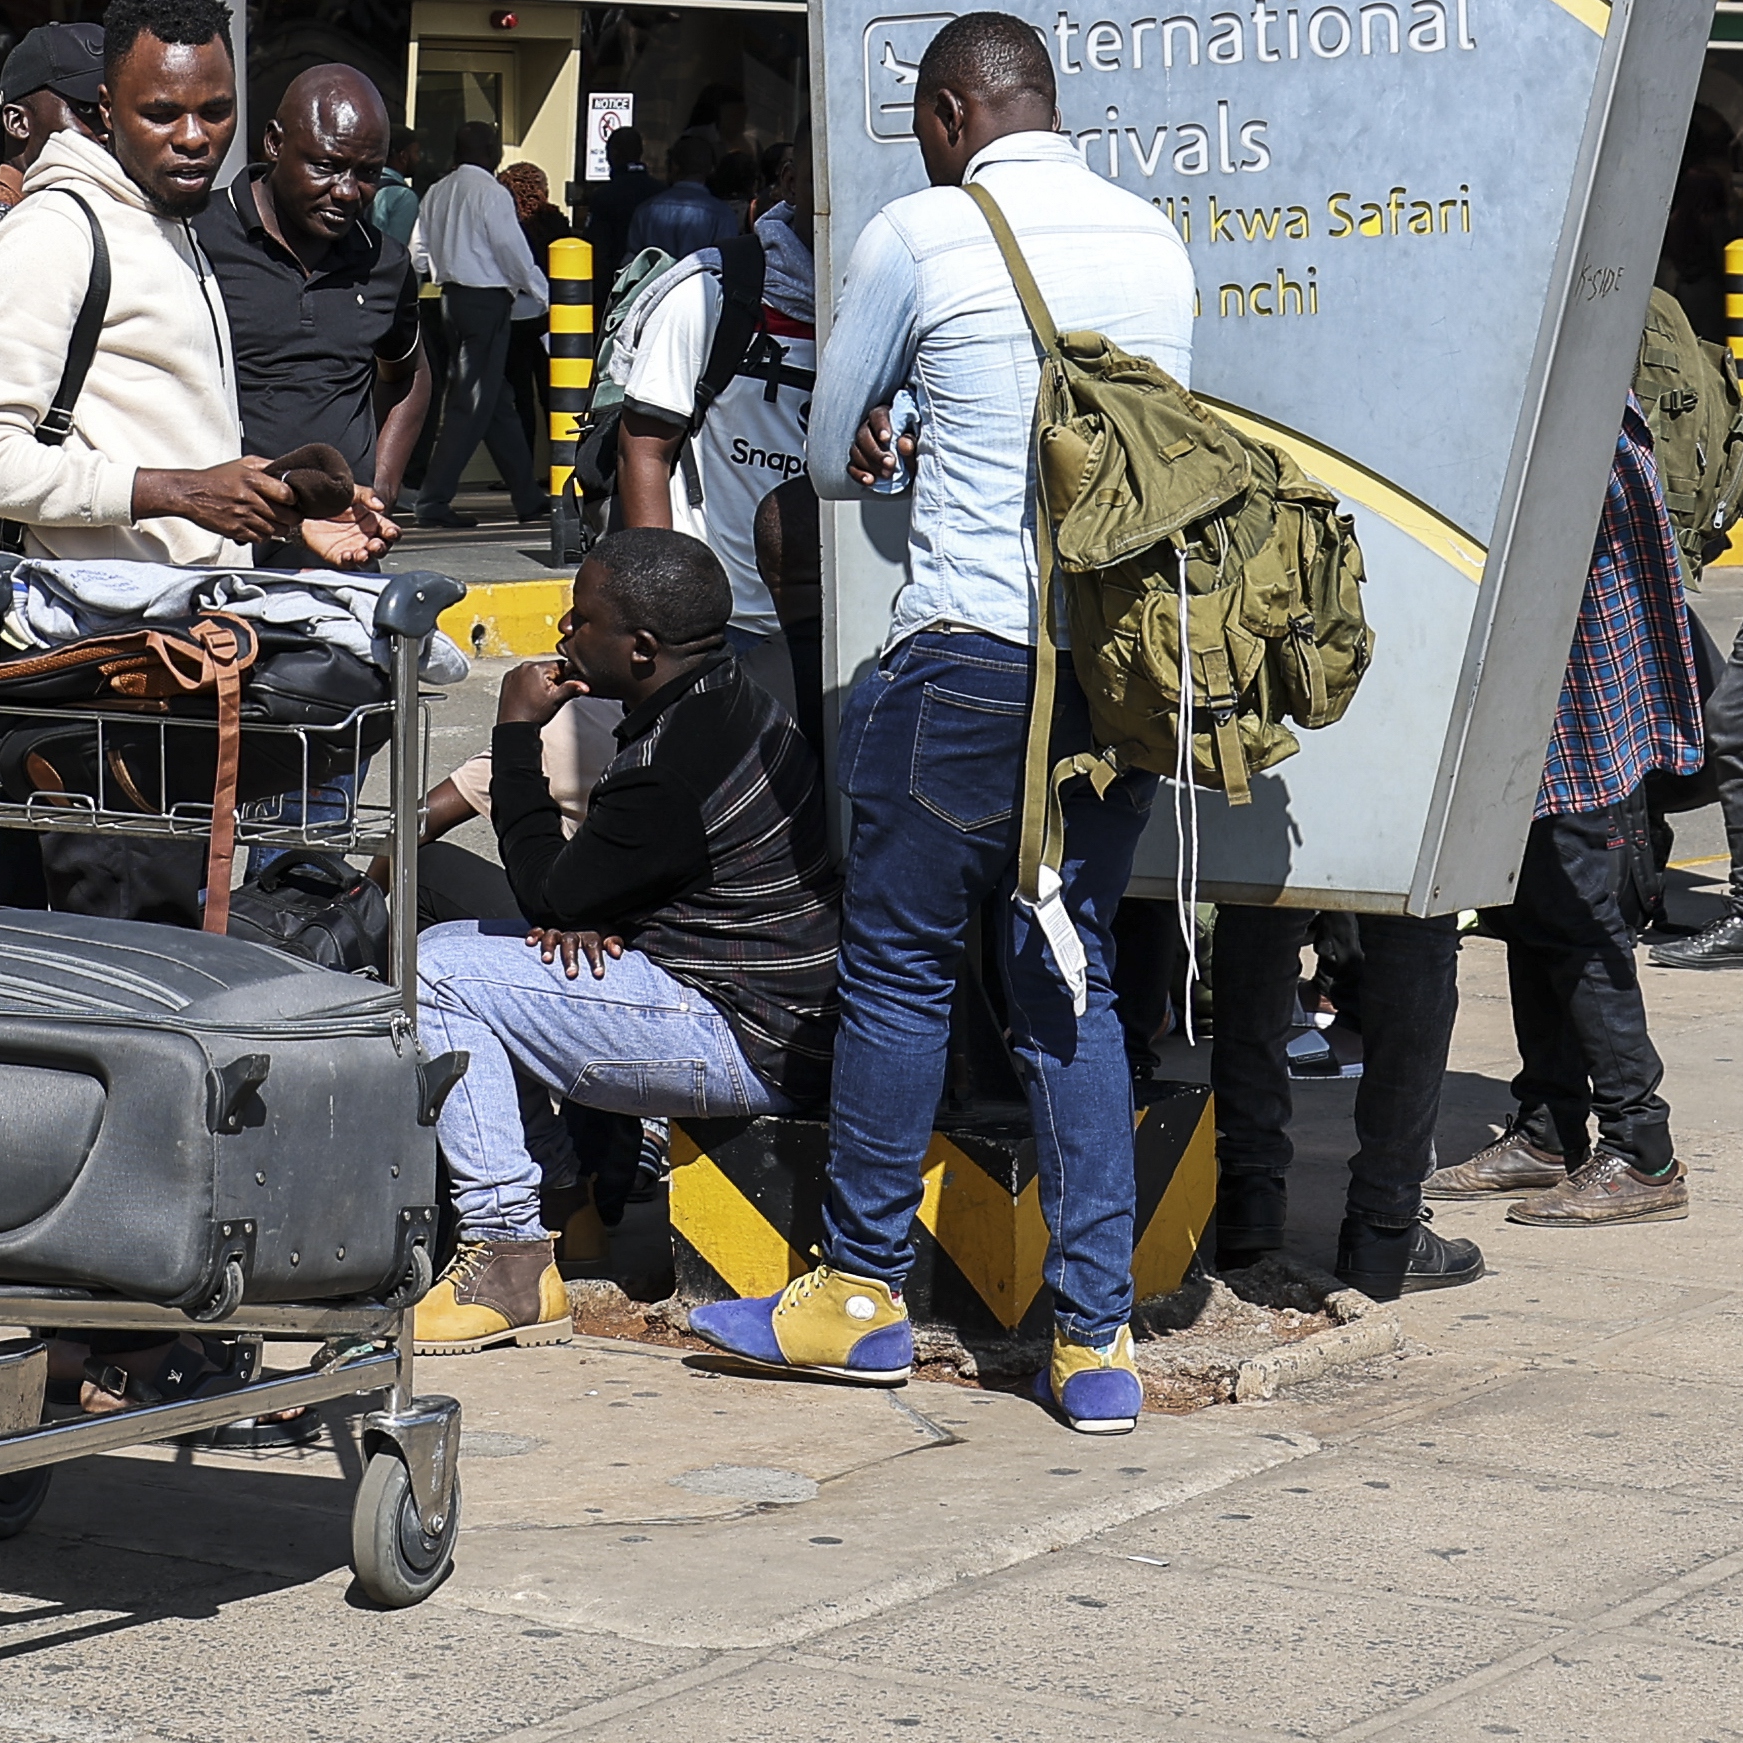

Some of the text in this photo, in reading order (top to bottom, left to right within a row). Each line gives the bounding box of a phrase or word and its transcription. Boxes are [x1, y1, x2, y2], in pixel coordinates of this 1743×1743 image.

[594, 98, 630, 109] NOTICE
[1059, 100, 1272, 177] rivals
[1208, 195, 1310, 243] kwa
[1327, 184, 1471, 239] Safari
[1218, 266, 1319, 317] nchi
